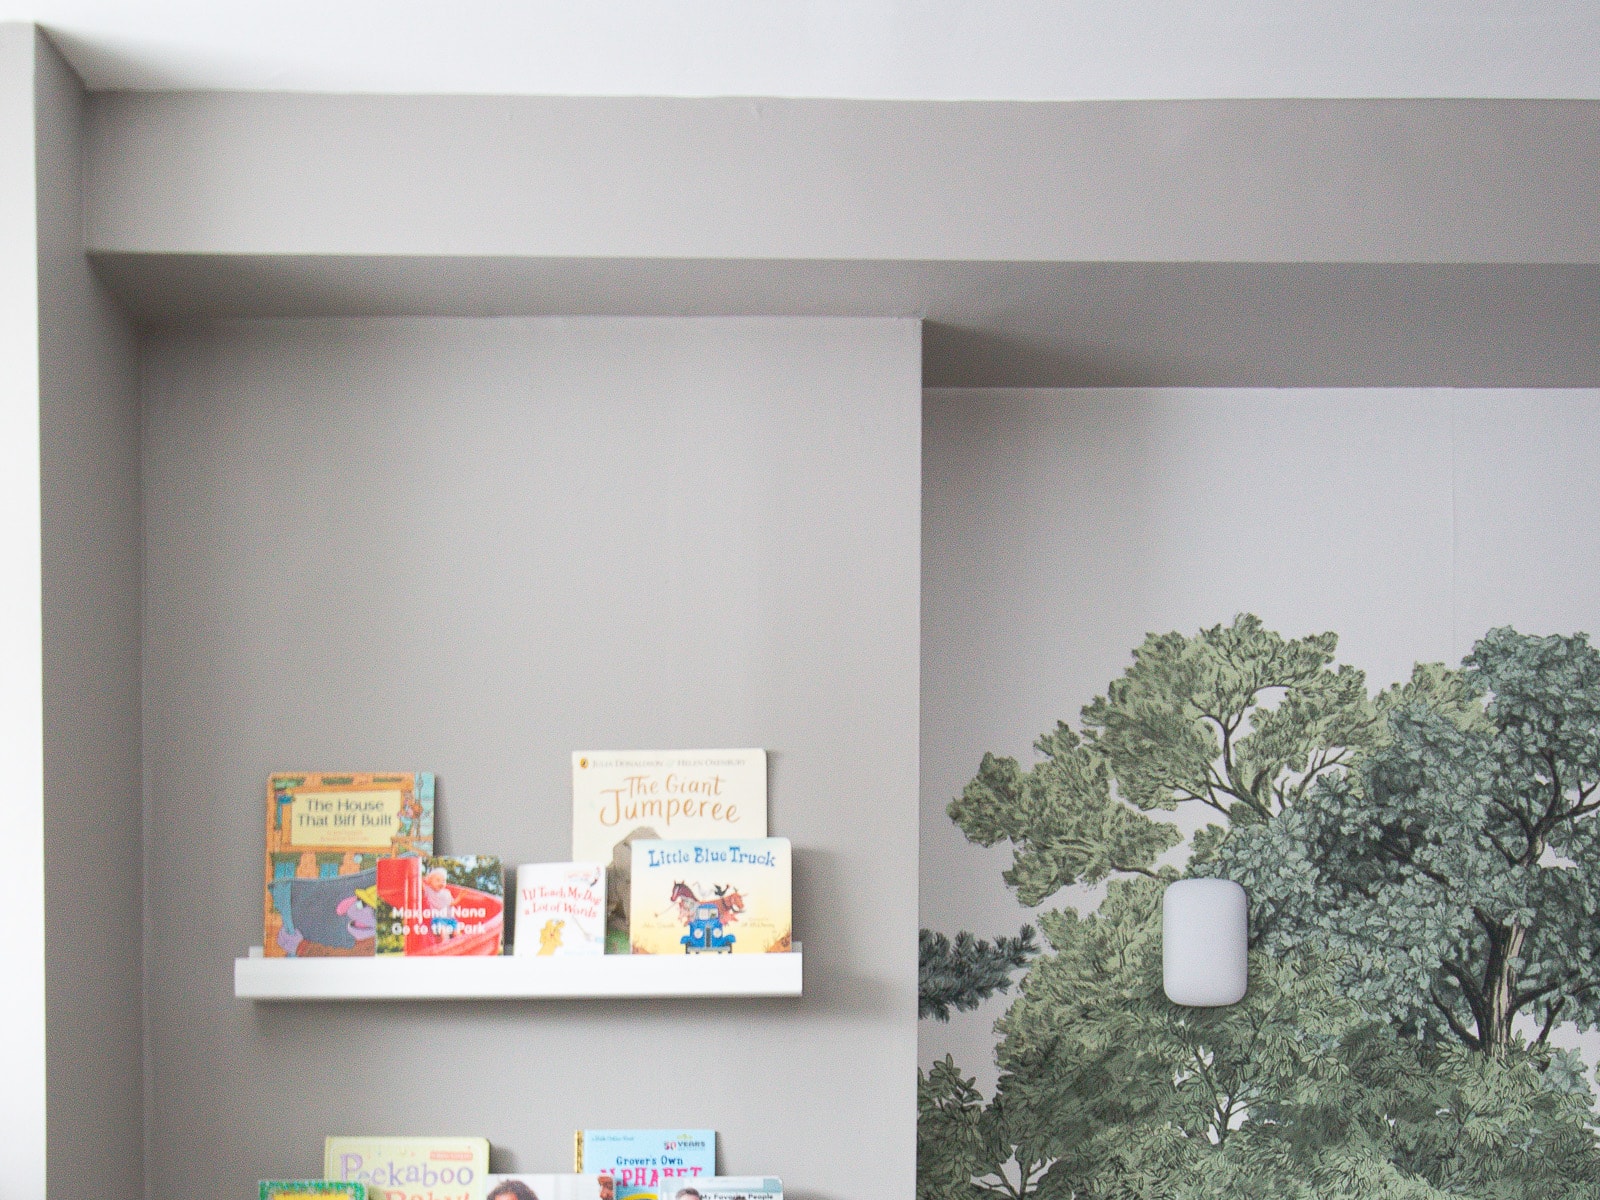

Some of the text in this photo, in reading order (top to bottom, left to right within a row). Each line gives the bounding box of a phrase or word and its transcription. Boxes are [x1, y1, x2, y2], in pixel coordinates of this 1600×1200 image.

[623, 773, 727, 799] The Giant
[305, 798, 384, 812] The House
[600, 787, 741, 827] Jumperee
[297, 812, 392, 827] That Biff Built
[648, 845, 777, 867] Little Blue Truck
[539, 886, 566, 899] Teach
[568, 886, 581, 900] My
[583, 889, 602, 906] Dog
[423, 906, 447, 918] and
[452, 906, 486, 918] Nana
[532, 902, 548, 913] Lot
[550, 902, 559, 912] of
[563, 902, 597, 918] Words
[392, 922, 485, 935] Go to the Park
[616, 1155, 684, 1166] Grover's Own
[748, 1193, 774, 1200] People
